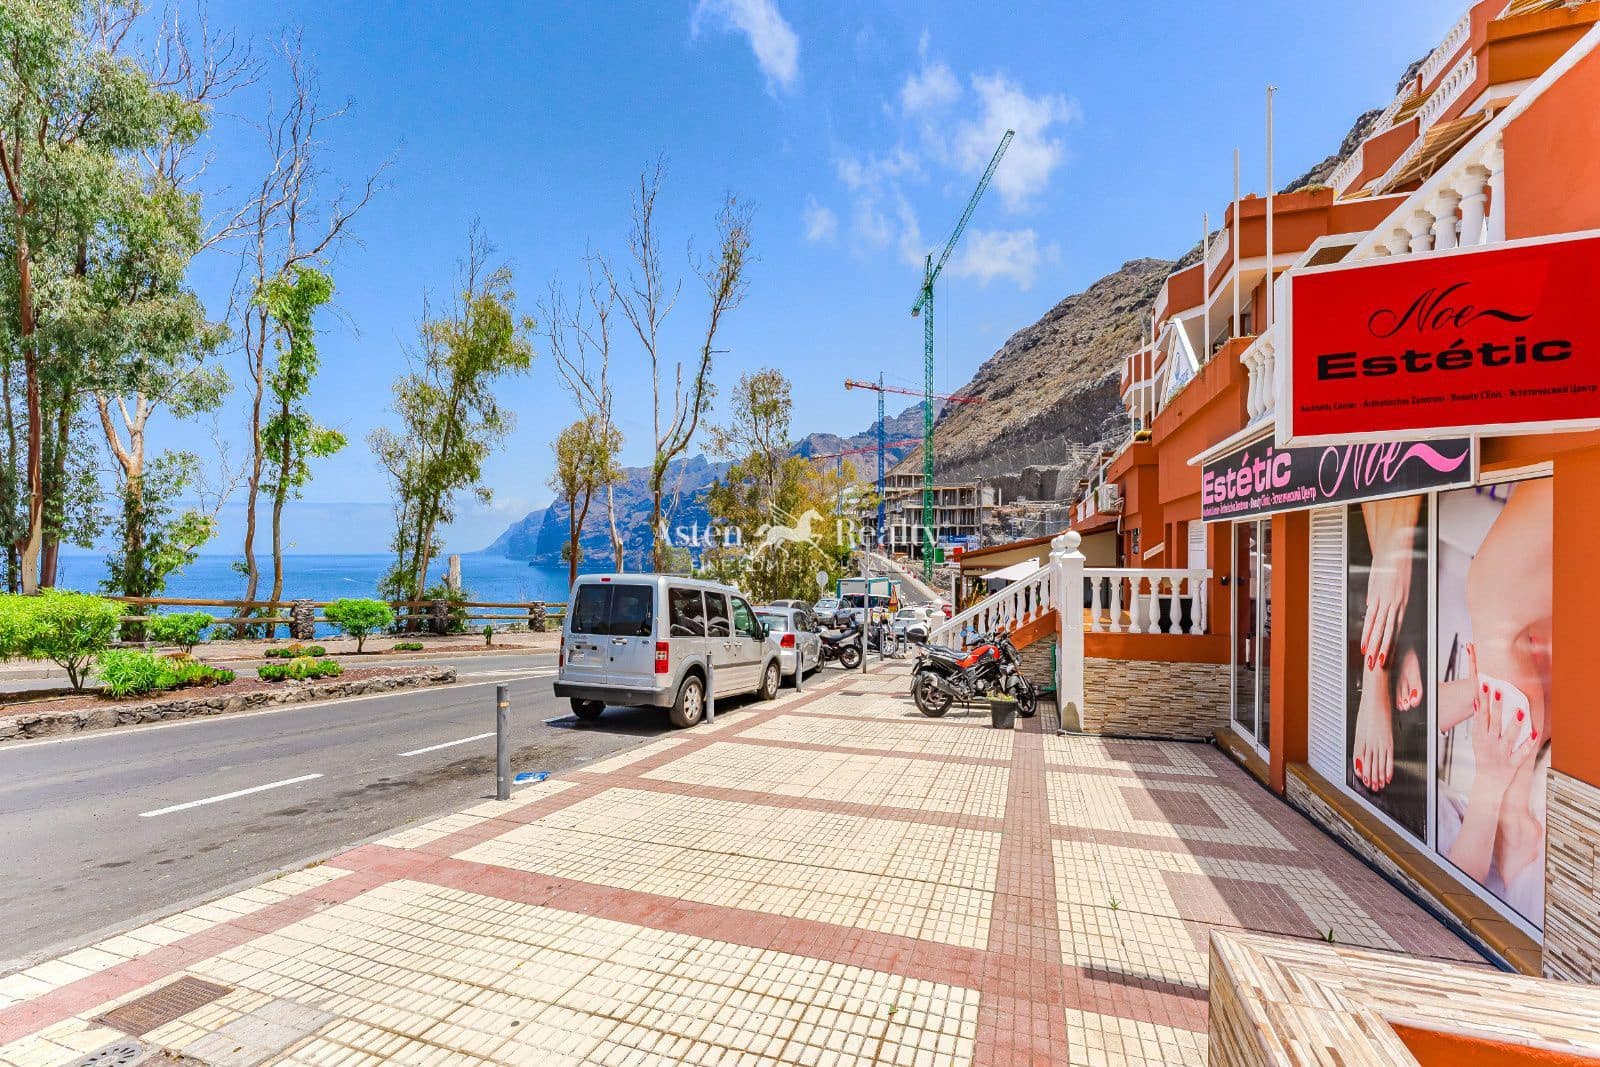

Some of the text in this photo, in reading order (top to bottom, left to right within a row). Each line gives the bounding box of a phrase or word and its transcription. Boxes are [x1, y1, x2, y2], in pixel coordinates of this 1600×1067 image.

[1367, 281, 1534, 339] Noe
[1317, 336, 1572, 381] Estétic
[1202, 447, 1291, 505] Estétic
